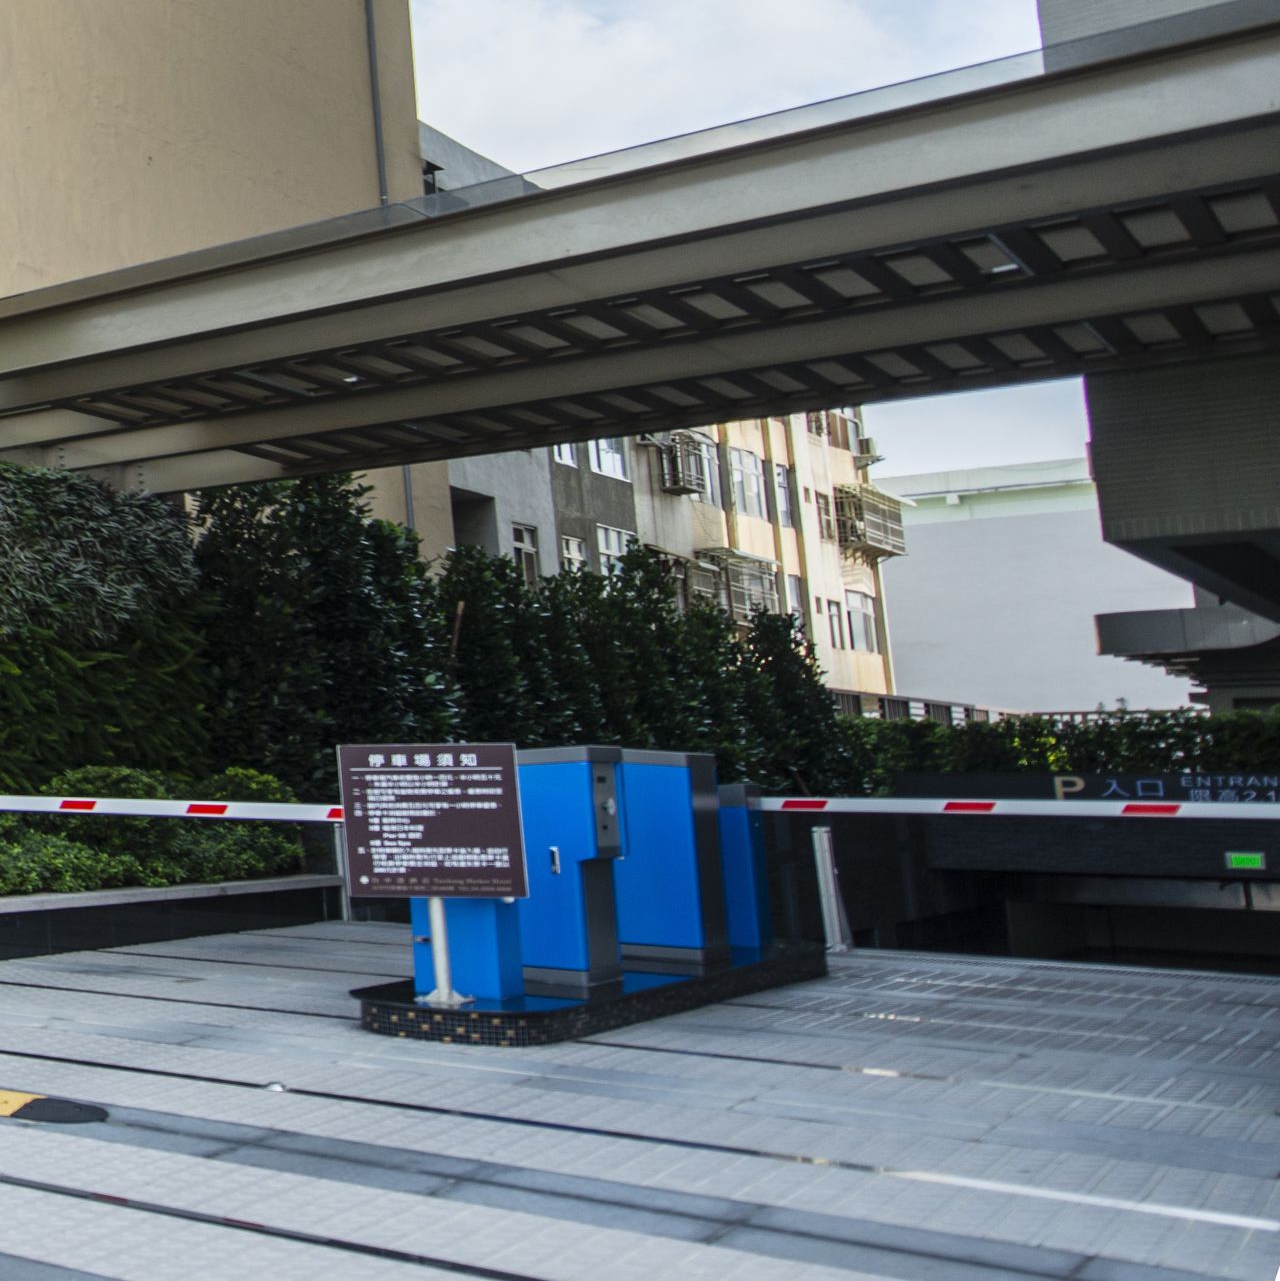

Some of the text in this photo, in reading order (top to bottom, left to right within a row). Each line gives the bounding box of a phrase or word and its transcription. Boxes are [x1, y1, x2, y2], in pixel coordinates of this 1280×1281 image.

[368, 754, 477, 767] 停車場須知
[1054, 776, 1278, 799] P 入口 ENTRAN
